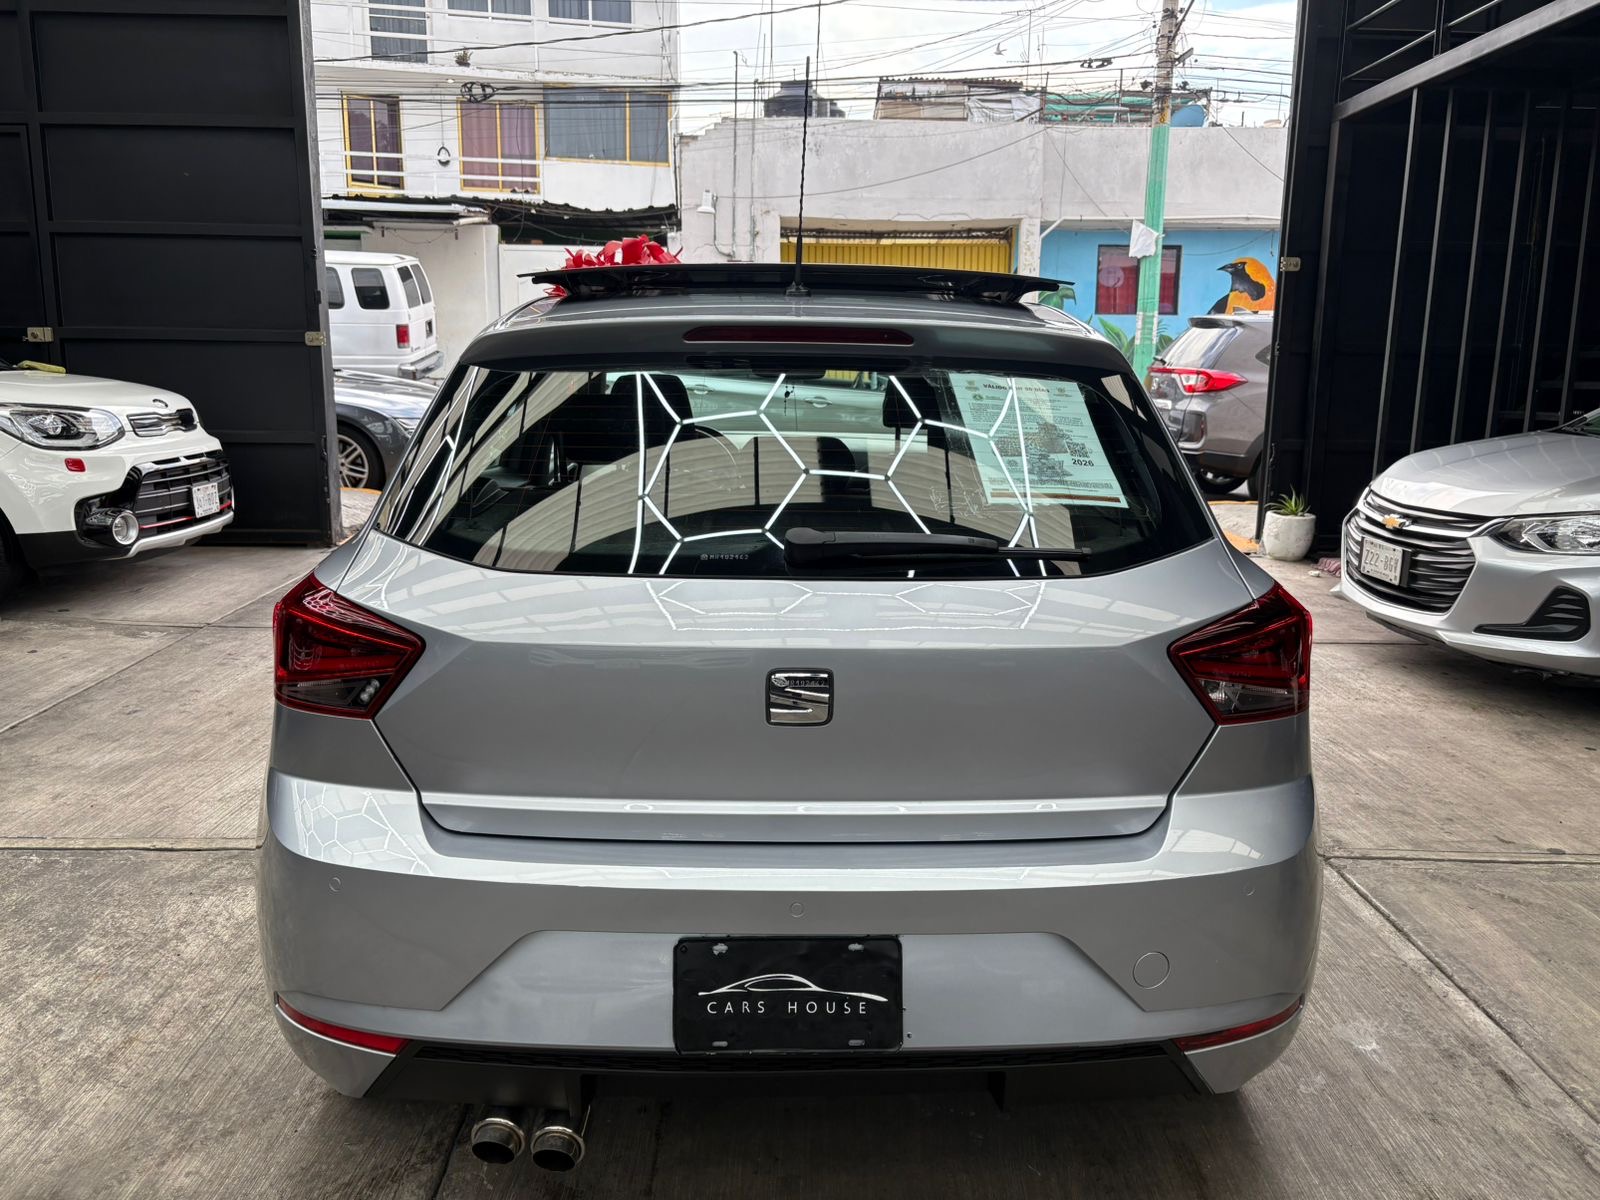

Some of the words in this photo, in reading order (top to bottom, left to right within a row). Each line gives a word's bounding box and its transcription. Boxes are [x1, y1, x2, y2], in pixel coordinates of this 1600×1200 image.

[1071, 458, 1095, 467] 2026
[706, 1001, 766, 1014] CARS
[787, 1001, 867, 1014] HOUSE
